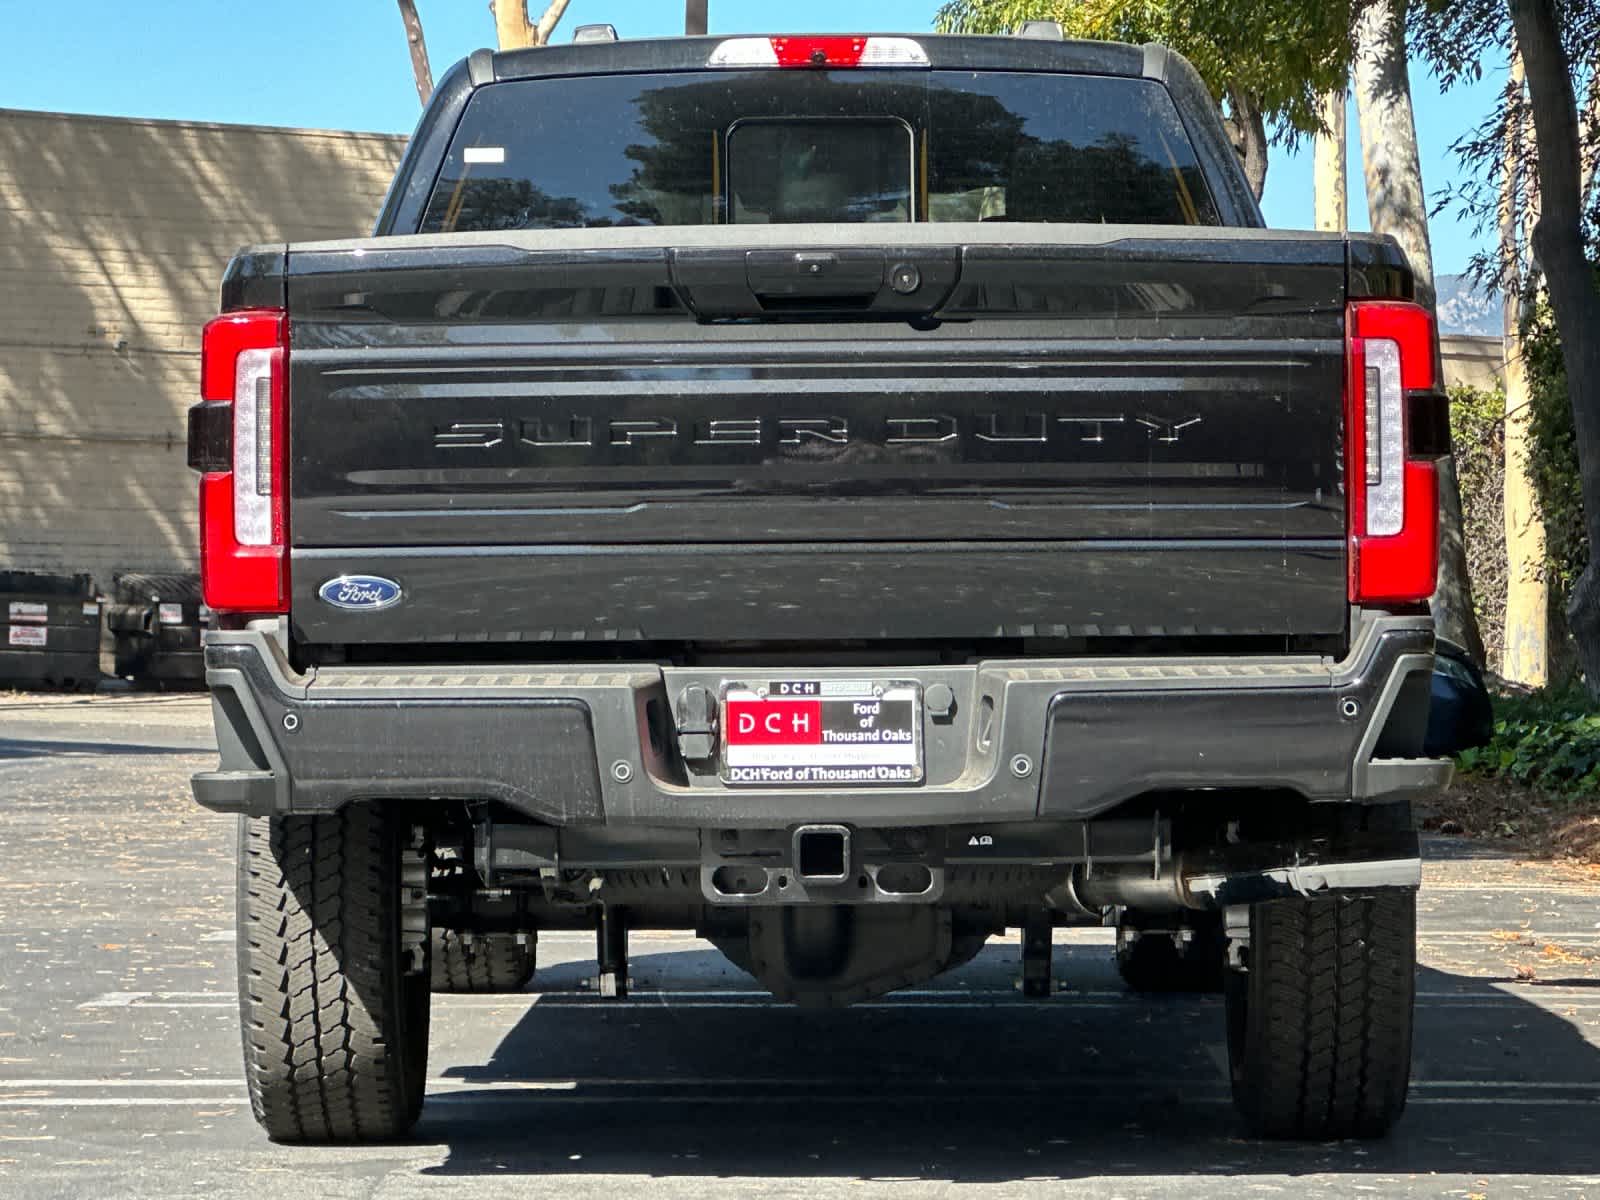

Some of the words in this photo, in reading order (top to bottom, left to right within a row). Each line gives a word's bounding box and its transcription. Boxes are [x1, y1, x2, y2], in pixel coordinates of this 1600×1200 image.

[433, 416, 849, 448] SUPER
[885, 412, 1202, 444] DUTY
[337, 580, 383, 602] Ford
[853, 702, 880, 715] Ford
[859, 715, 874, 729] of
[822, 729, 880, 742] Thousand
[881, 729, 912, 742] Oaks
[730, 767, 762, 781] DCH
[763, 766, 794, 781] Ford
[795, 766, 810, 780] of
[810, 766, 876, 780] Thousand
[877, 765, 912, 780] Oaks
